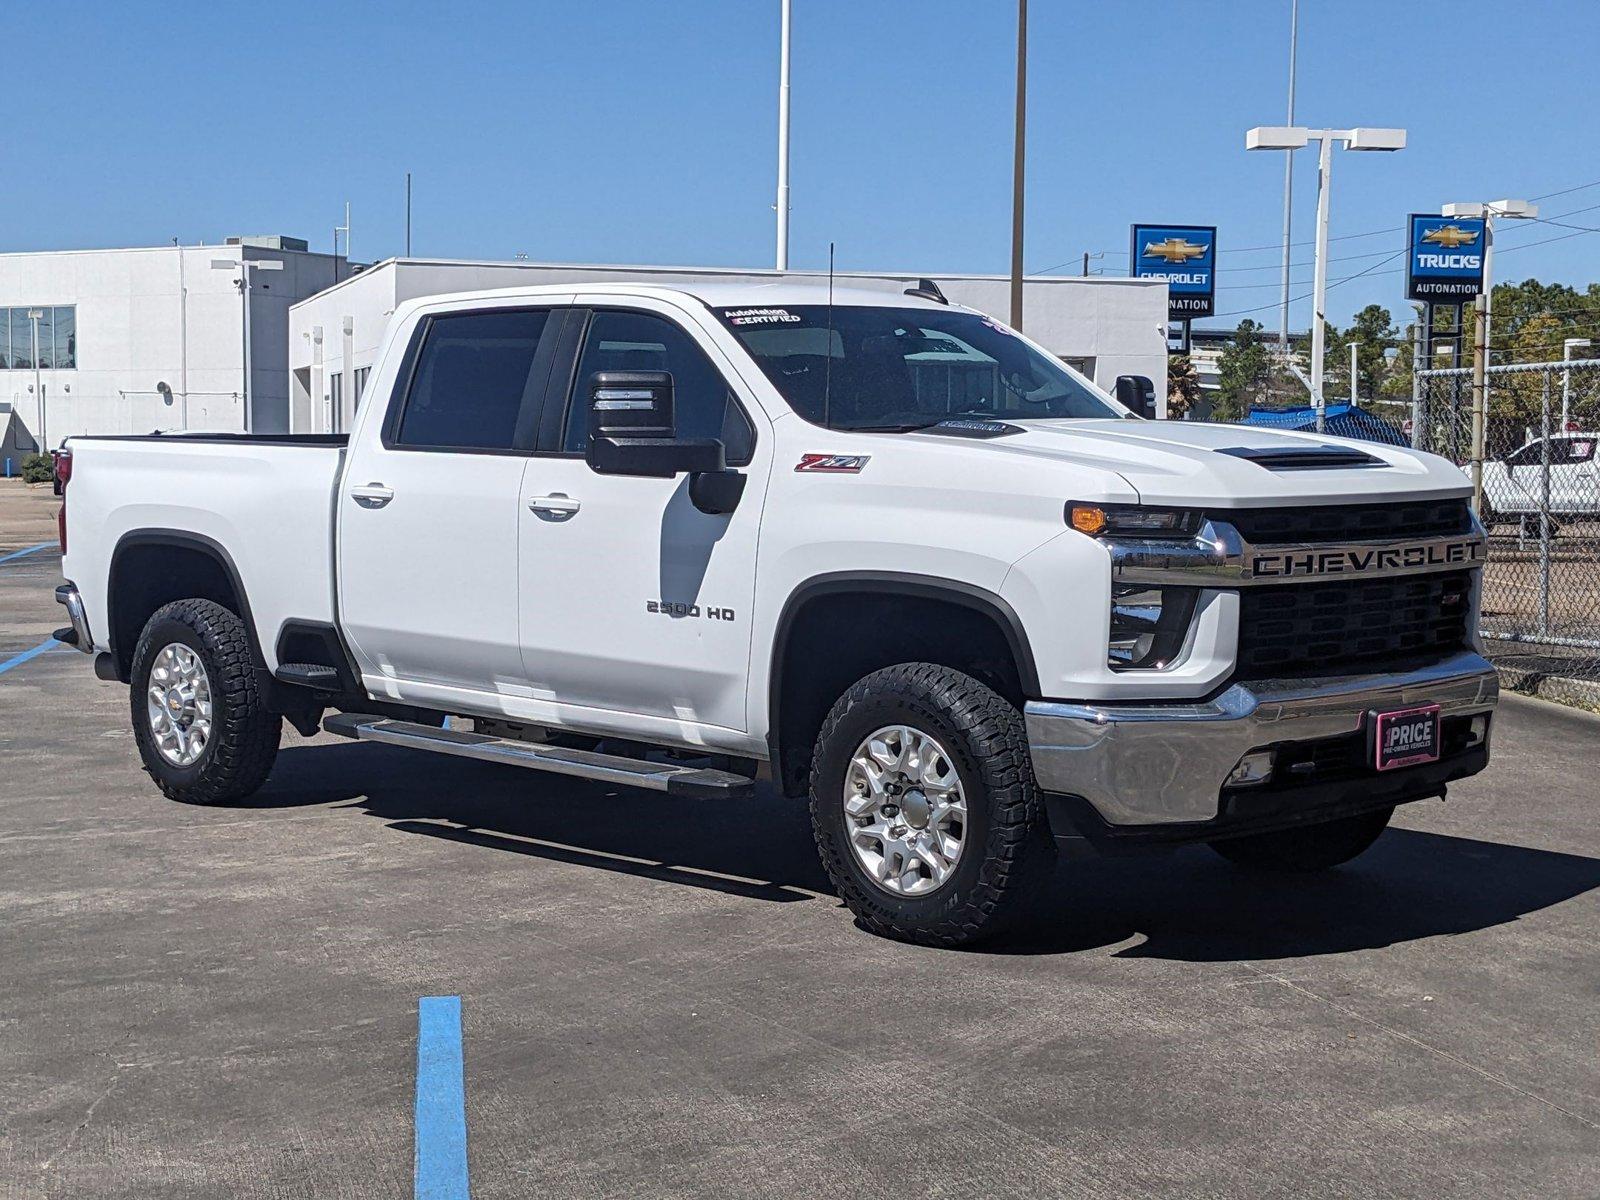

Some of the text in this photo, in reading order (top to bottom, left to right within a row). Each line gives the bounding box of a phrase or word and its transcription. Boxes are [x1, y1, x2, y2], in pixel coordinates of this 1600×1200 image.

[1417, 254, 1480, 269] TRUCKS
[1416, 283, 1479, 294] AUTONATION
[737, 315, 801, 325] CERTIFIED
[794, 453, 872, 474] Z71
[1252, 541, 1482, 577] CHEVROLET
[646, 600, 735, 622] 2500 HD
